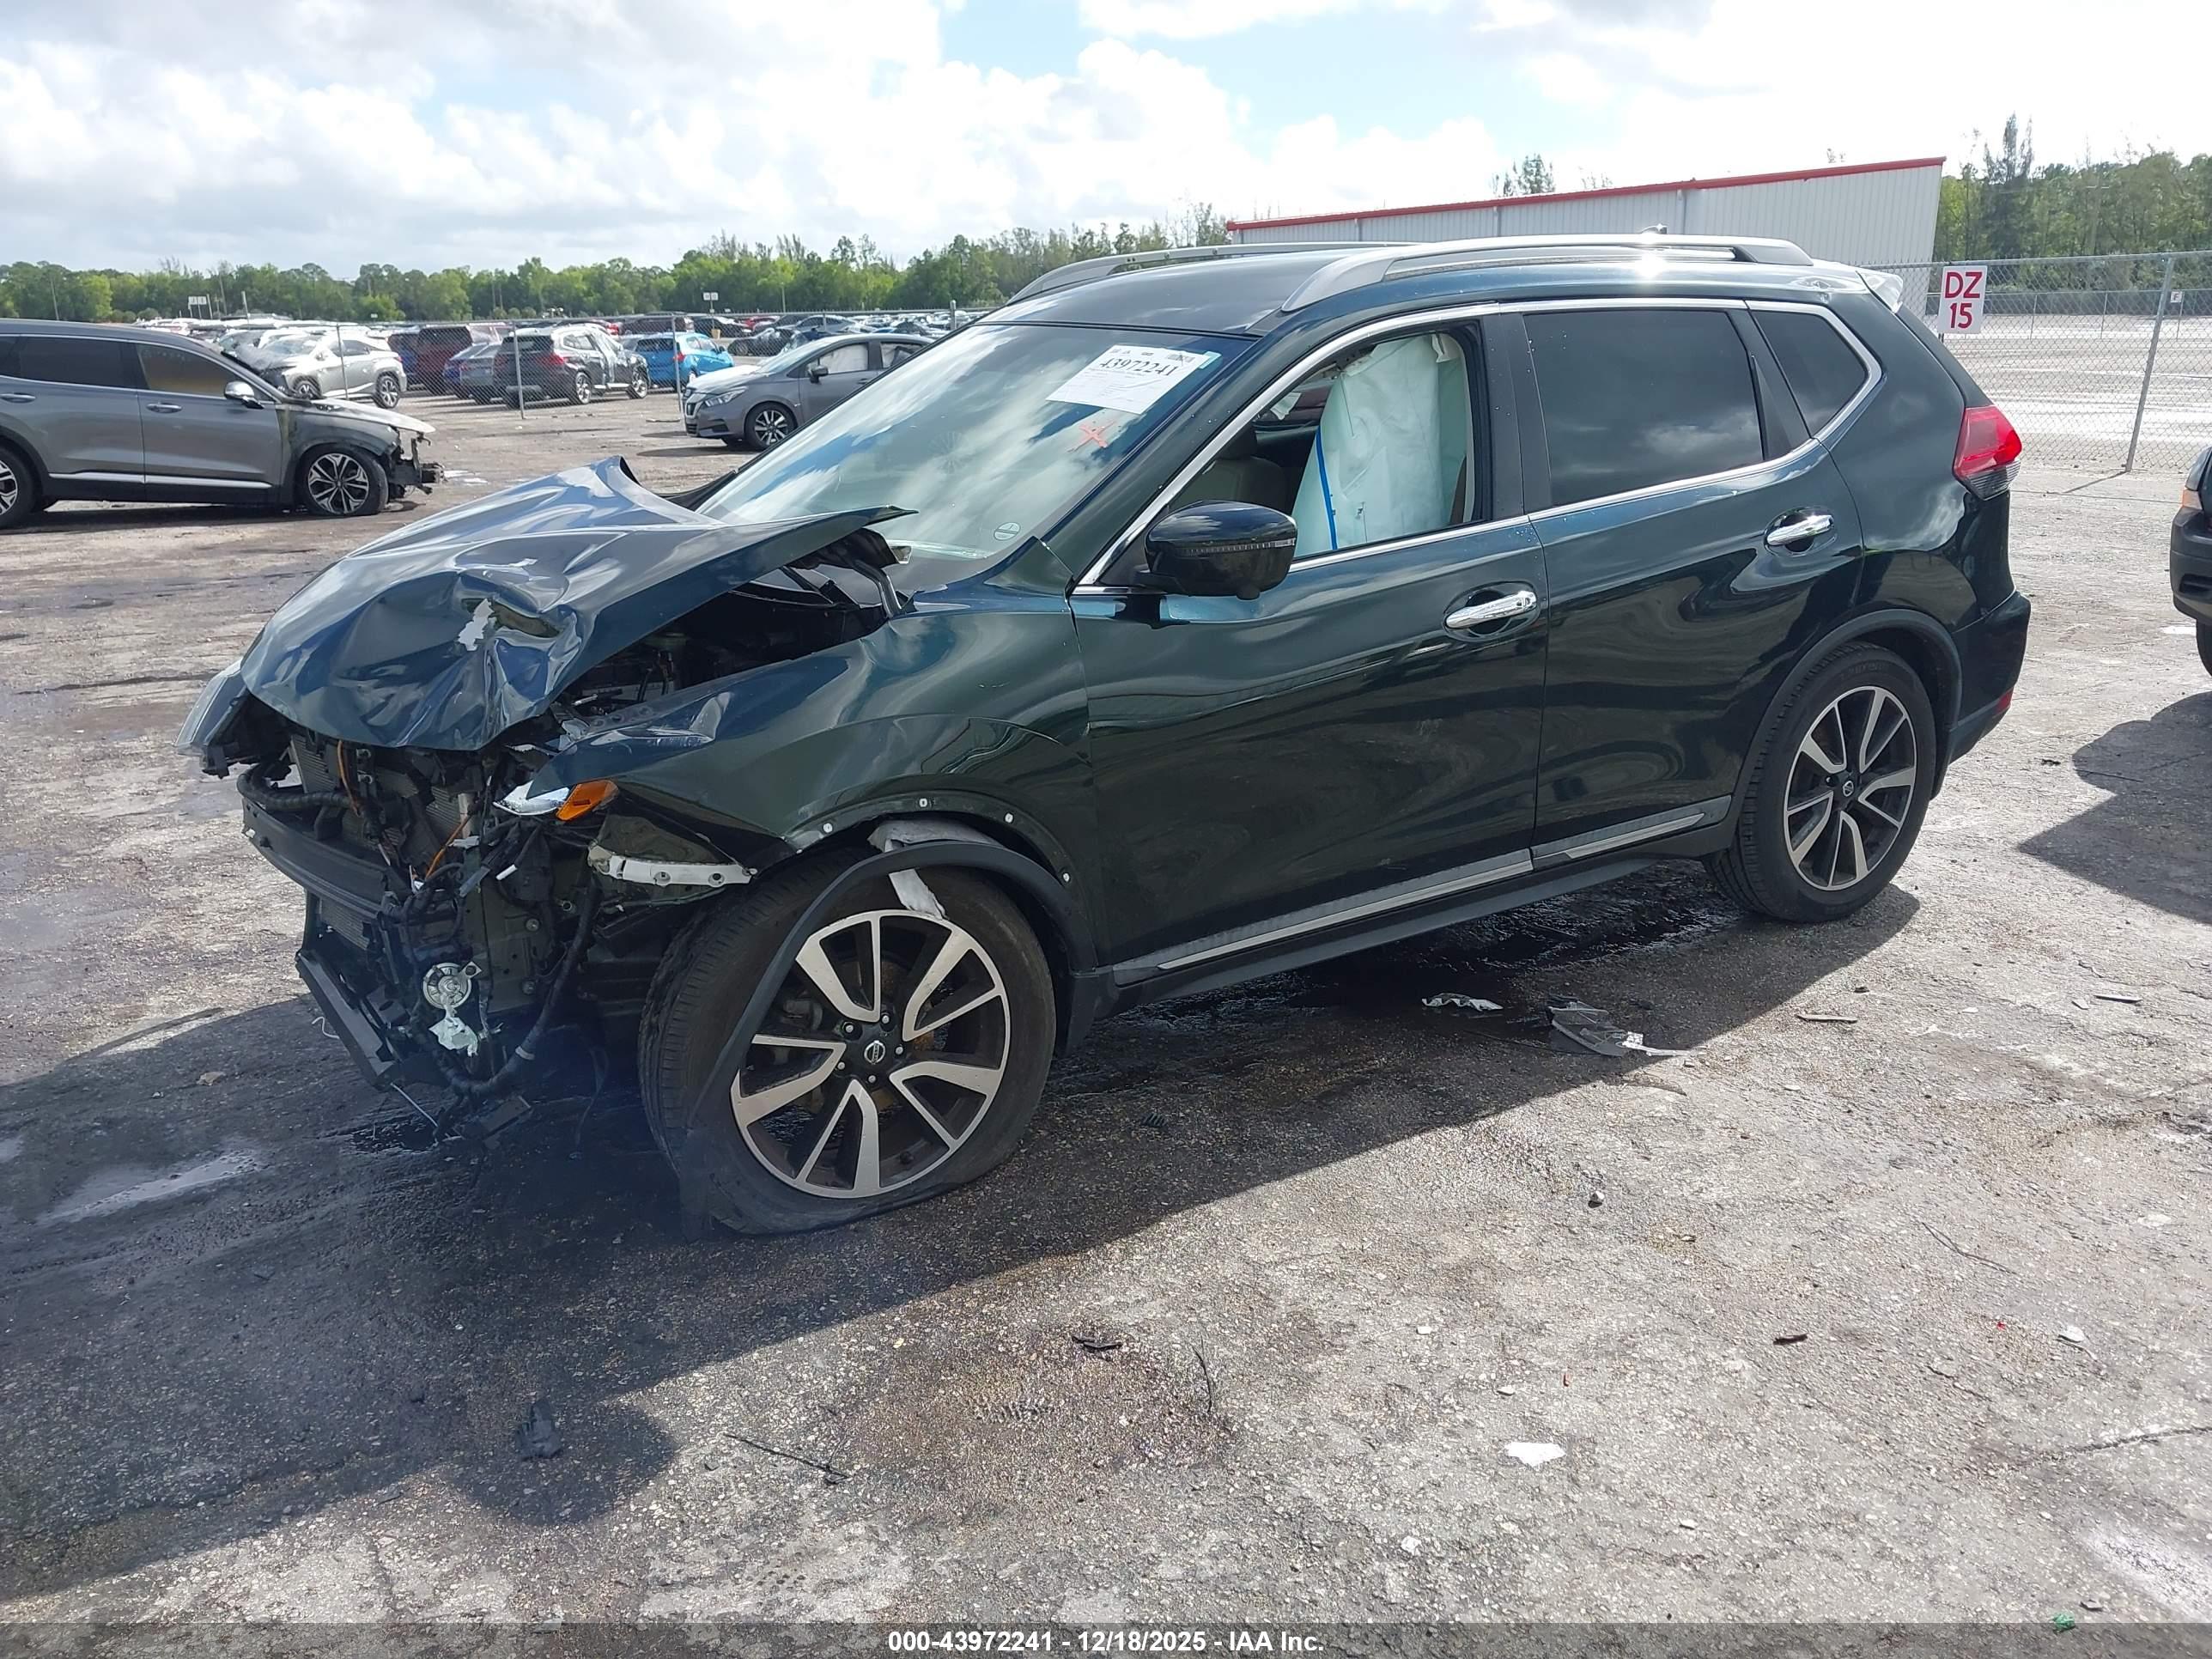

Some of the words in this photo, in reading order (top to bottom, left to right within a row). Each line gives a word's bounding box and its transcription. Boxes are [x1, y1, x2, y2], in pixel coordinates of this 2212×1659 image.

[1945, 271, 1983, 299] DZ
[1950, 302, 1972, 329] 15
[1100, 357, 1179, 376] 43972241
